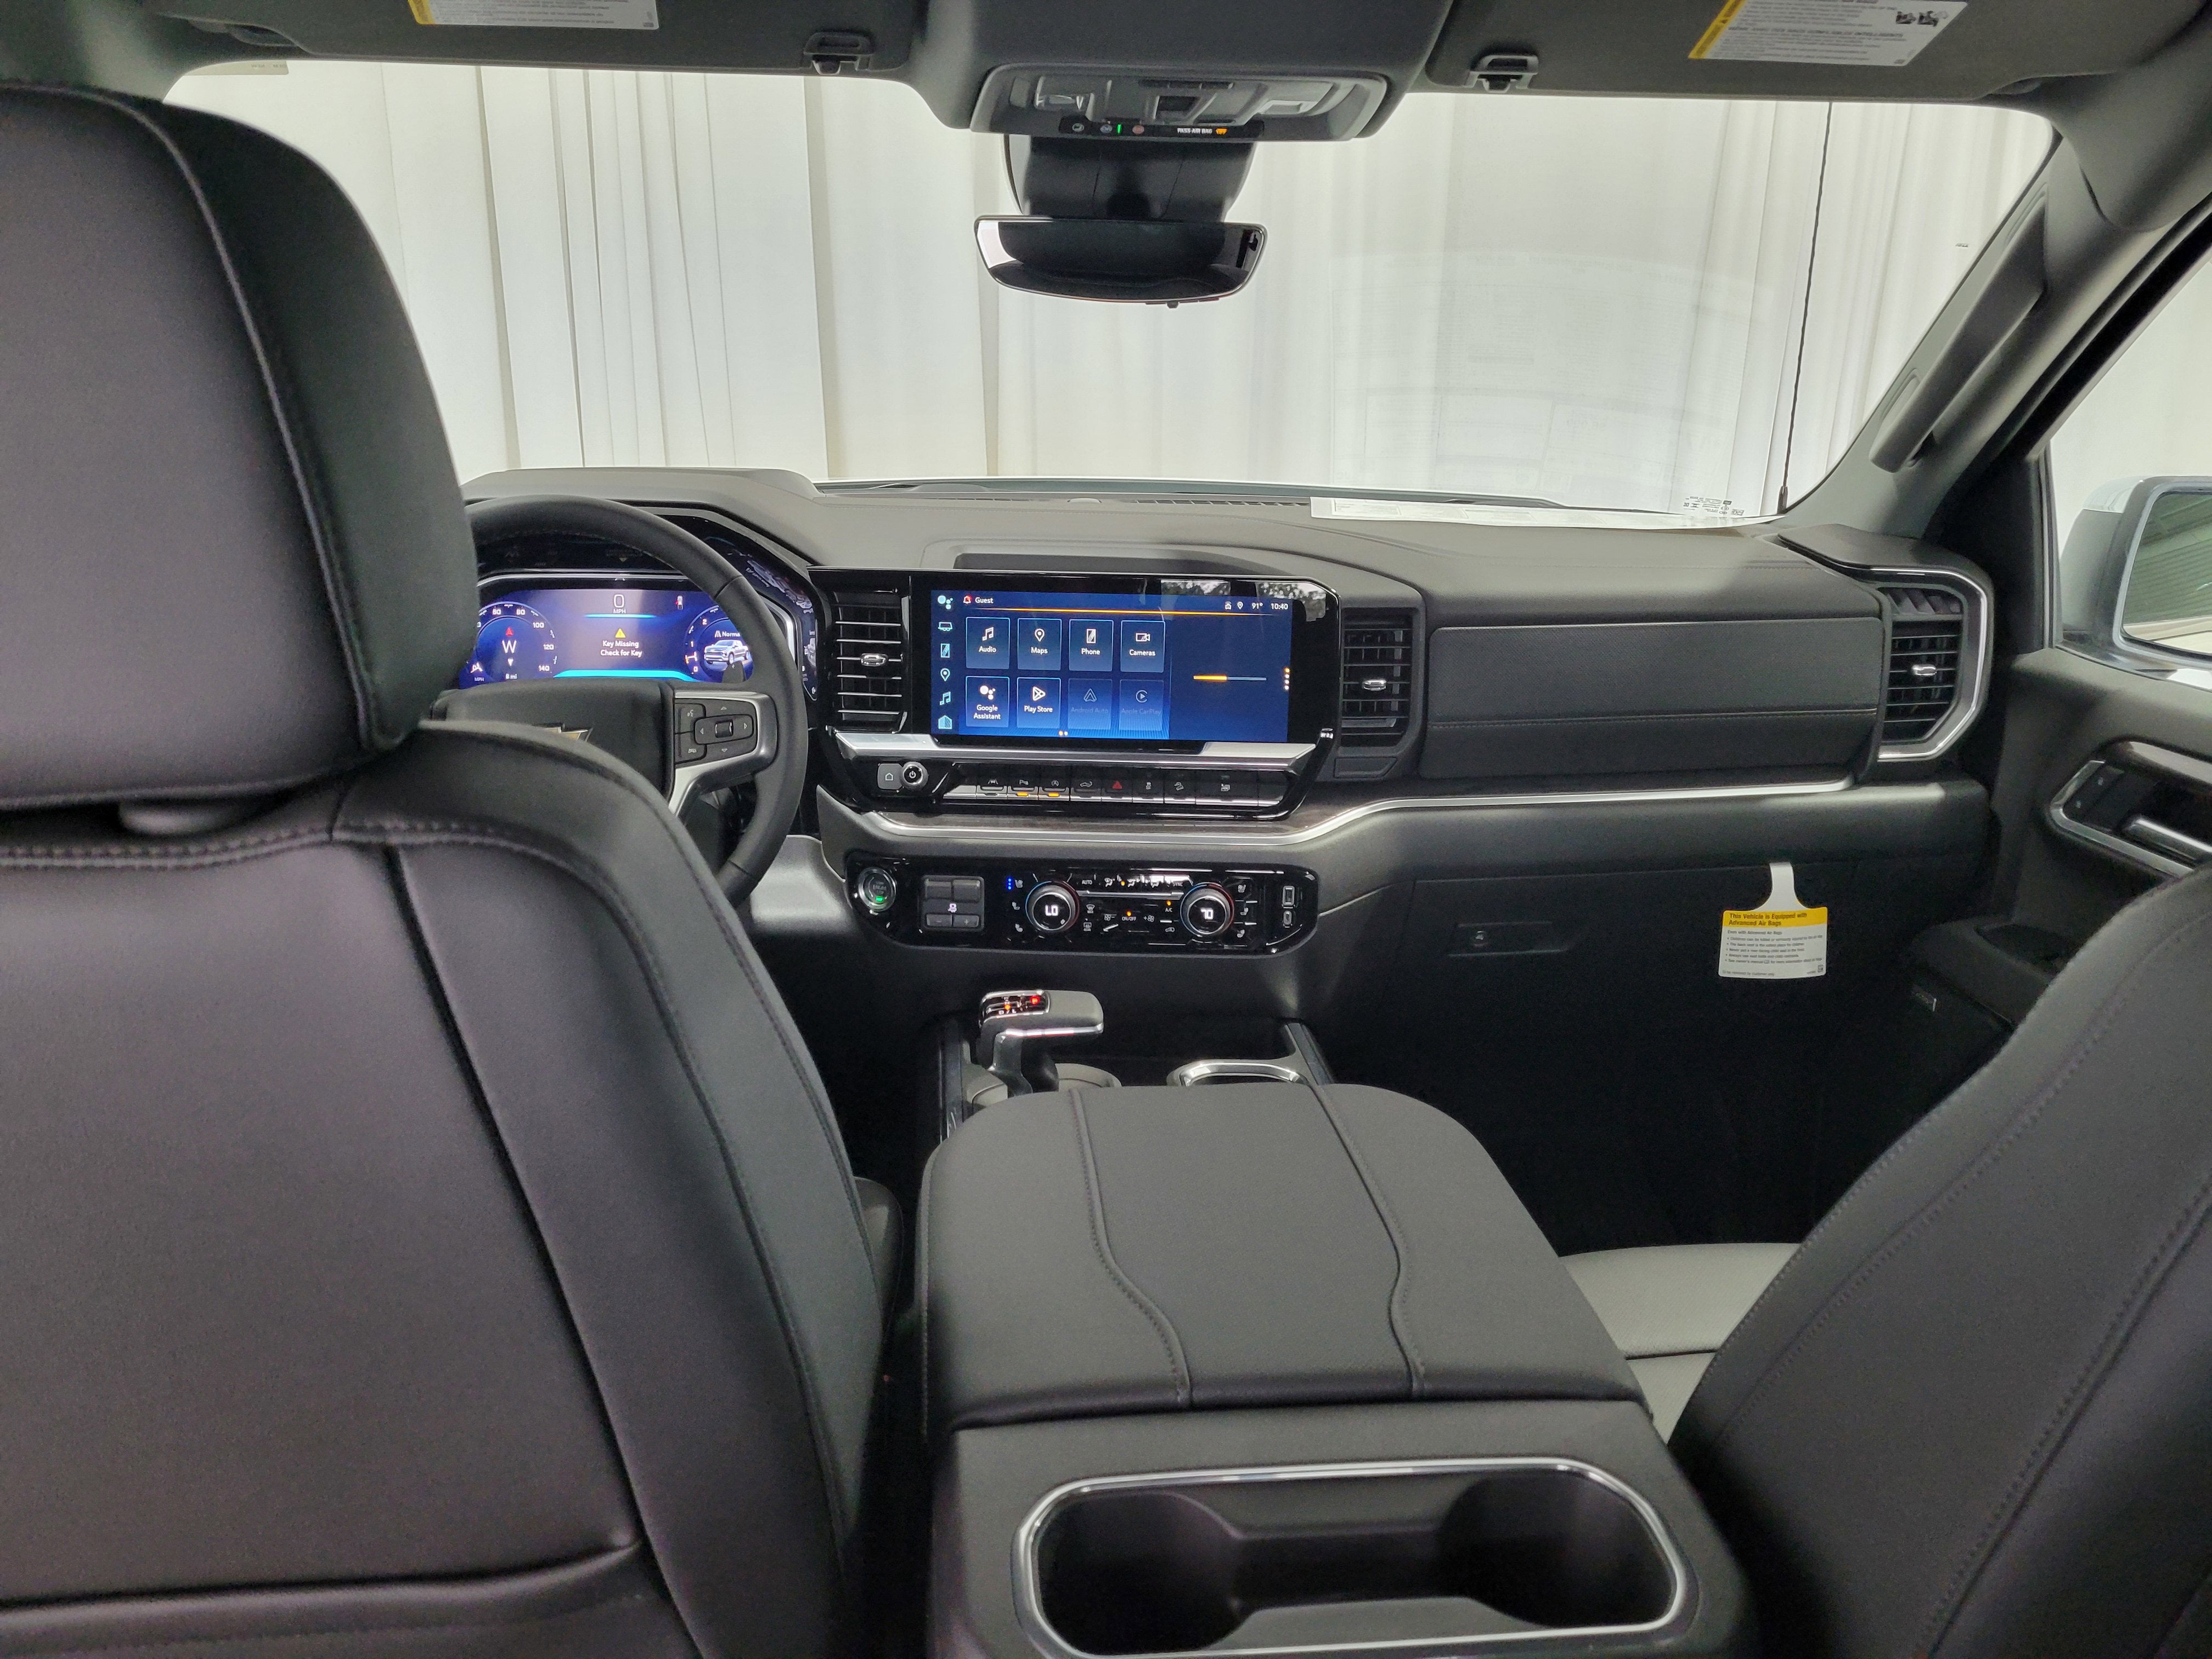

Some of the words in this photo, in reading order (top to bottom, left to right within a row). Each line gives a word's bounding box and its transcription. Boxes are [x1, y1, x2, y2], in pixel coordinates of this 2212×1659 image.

[613, 594, 625, 608] 0
[501, 640, 517, 654] W
[602, 640, 614, 648] Key
[615, 640, 640, 648] Missing
[631, 650, 643, 658] Key
[1030, 647, 1048, 655] Maps
[977, 704, 998, 713] Google
[1024, 706, 1036, 714] Play
[1045, 905, 1059, 917] LO
[1200, 909, 1214, 920] 70
